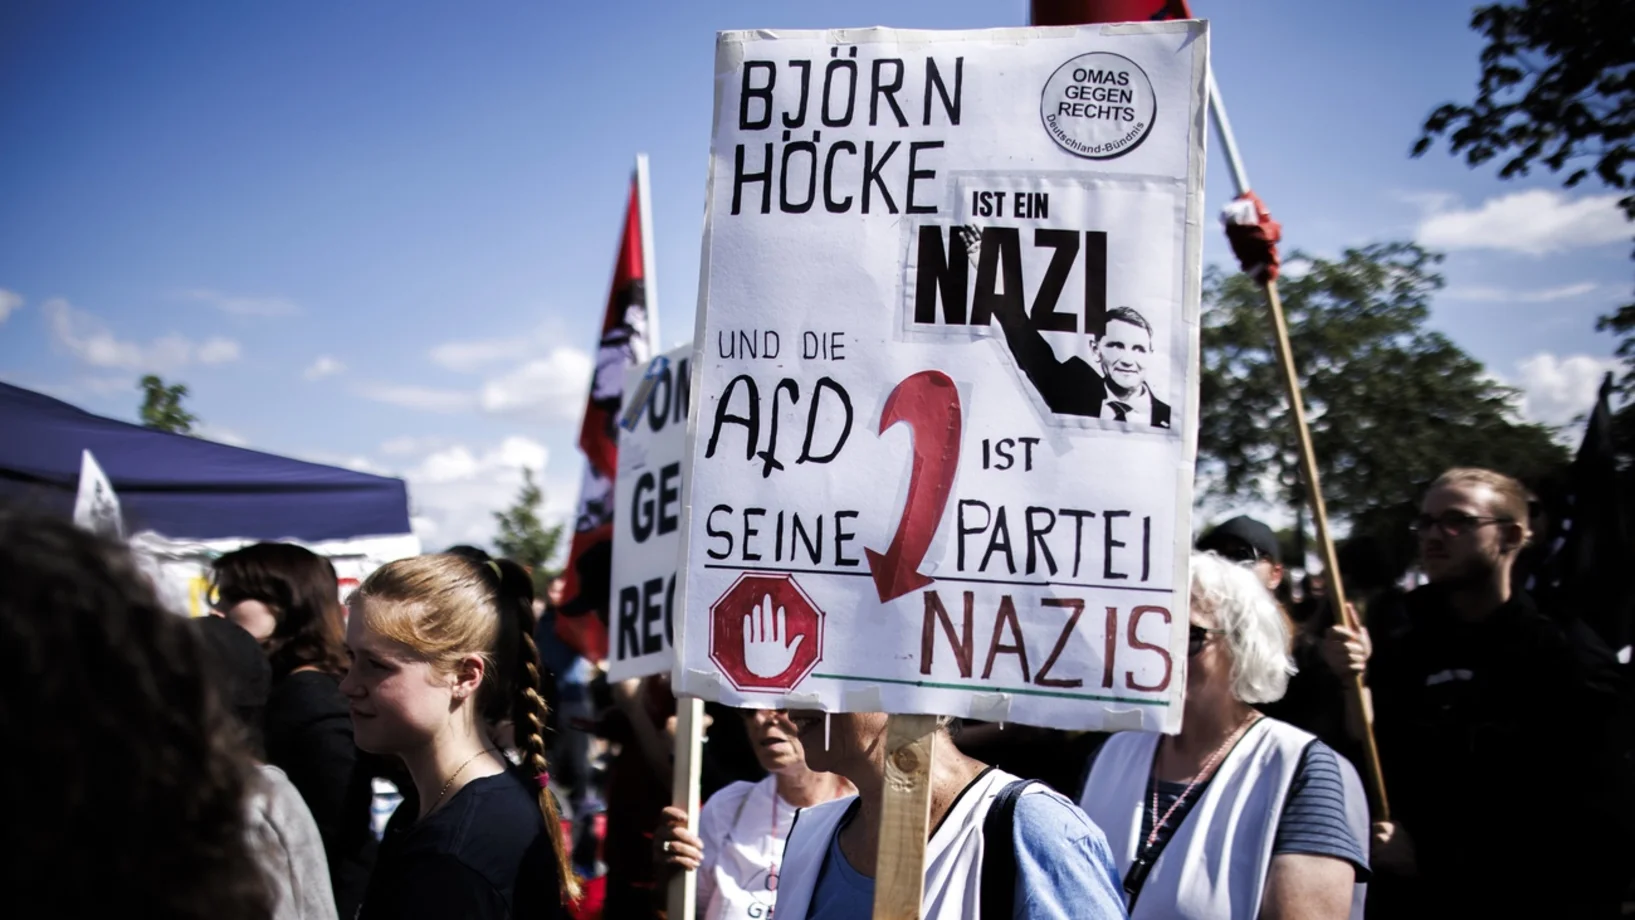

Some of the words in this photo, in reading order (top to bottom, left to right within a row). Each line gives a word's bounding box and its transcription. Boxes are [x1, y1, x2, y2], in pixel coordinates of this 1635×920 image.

[739, 46, 964, 130] BJÖRN
[1064, 85, 1133, 104] GEGEN
[1072, 68, 1130, 86] OMAS
[1046, 113, 1145, 153] Deutschland-Bündnis
[1057, 101, 1135, 122] RECHTS
[731, 130, 944, 215] HÖCKE
[972, 191, 1004, 217] IST
[1013, 192, 1049, 218] EIN
[914, 224, 1108, 335] NAZI
[719, 330, 779, 359] UND
[803, 331, 845, 360] DIE
[705, 374, 853, 478] AfD
[983, 438, 1040, 471] IST
[704, 504, 859, 567] SEINE
[957, 500, 1150, 582] PARTEI
[919, 591, 1172, 692] NAZIS
